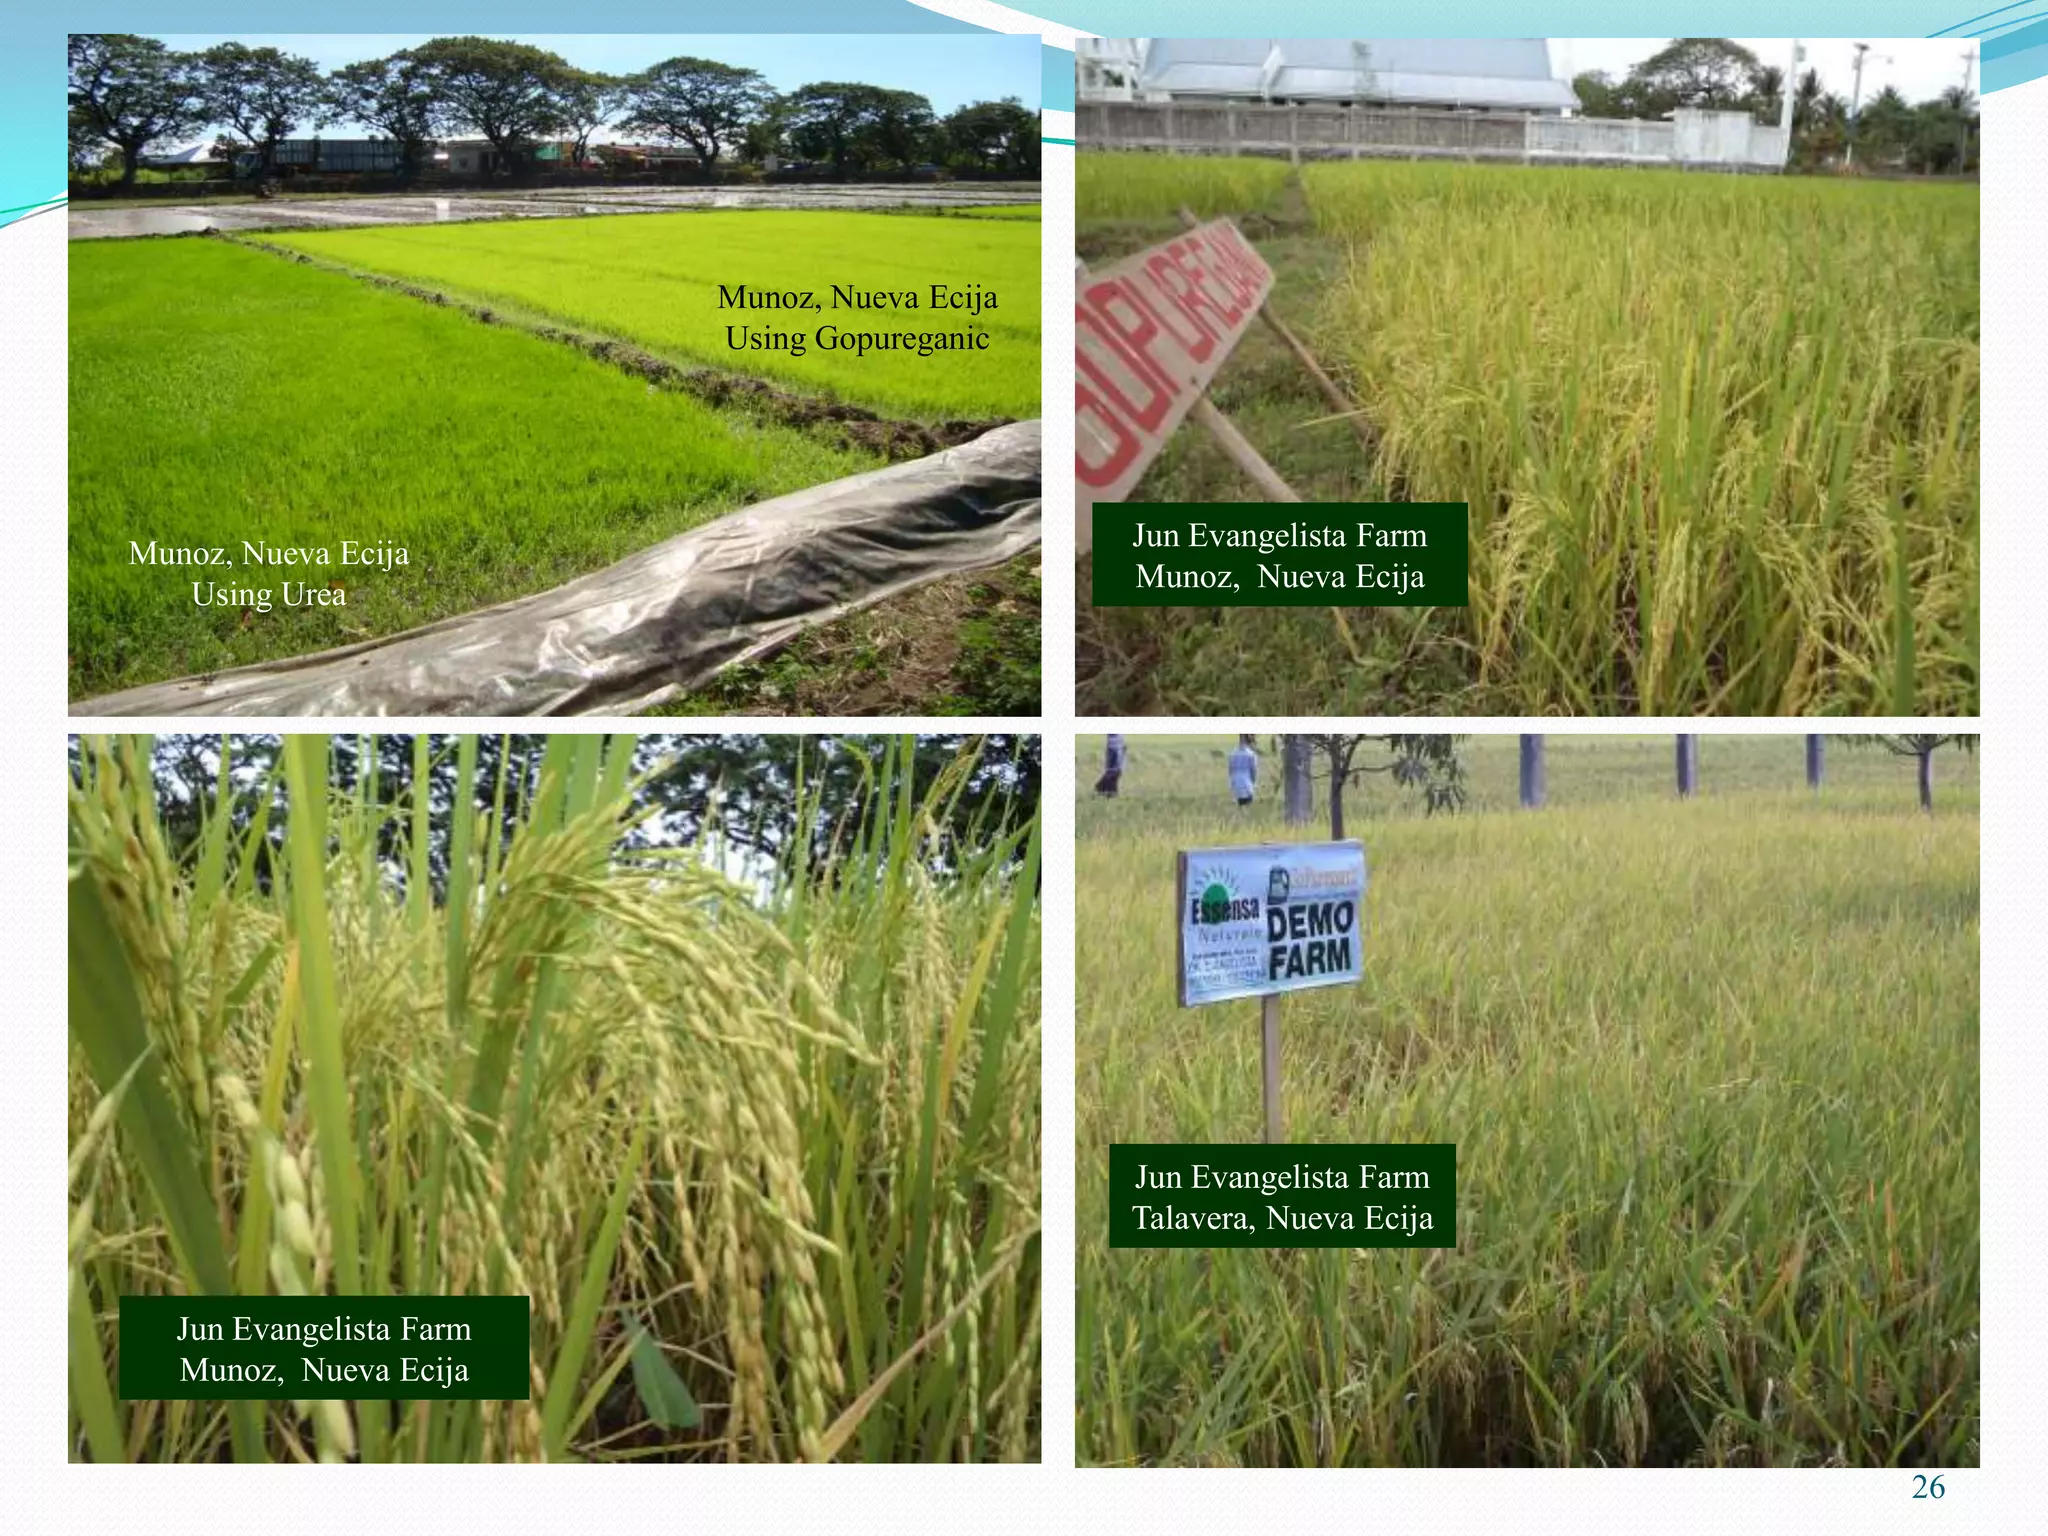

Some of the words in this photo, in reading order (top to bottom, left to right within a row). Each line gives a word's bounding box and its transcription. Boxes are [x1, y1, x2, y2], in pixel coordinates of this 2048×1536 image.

[1192, 898, 1260, 925] Essensa
[1267, 901, 1354, 943] DEMO
[1269, 937, 1351, 981] FARM
